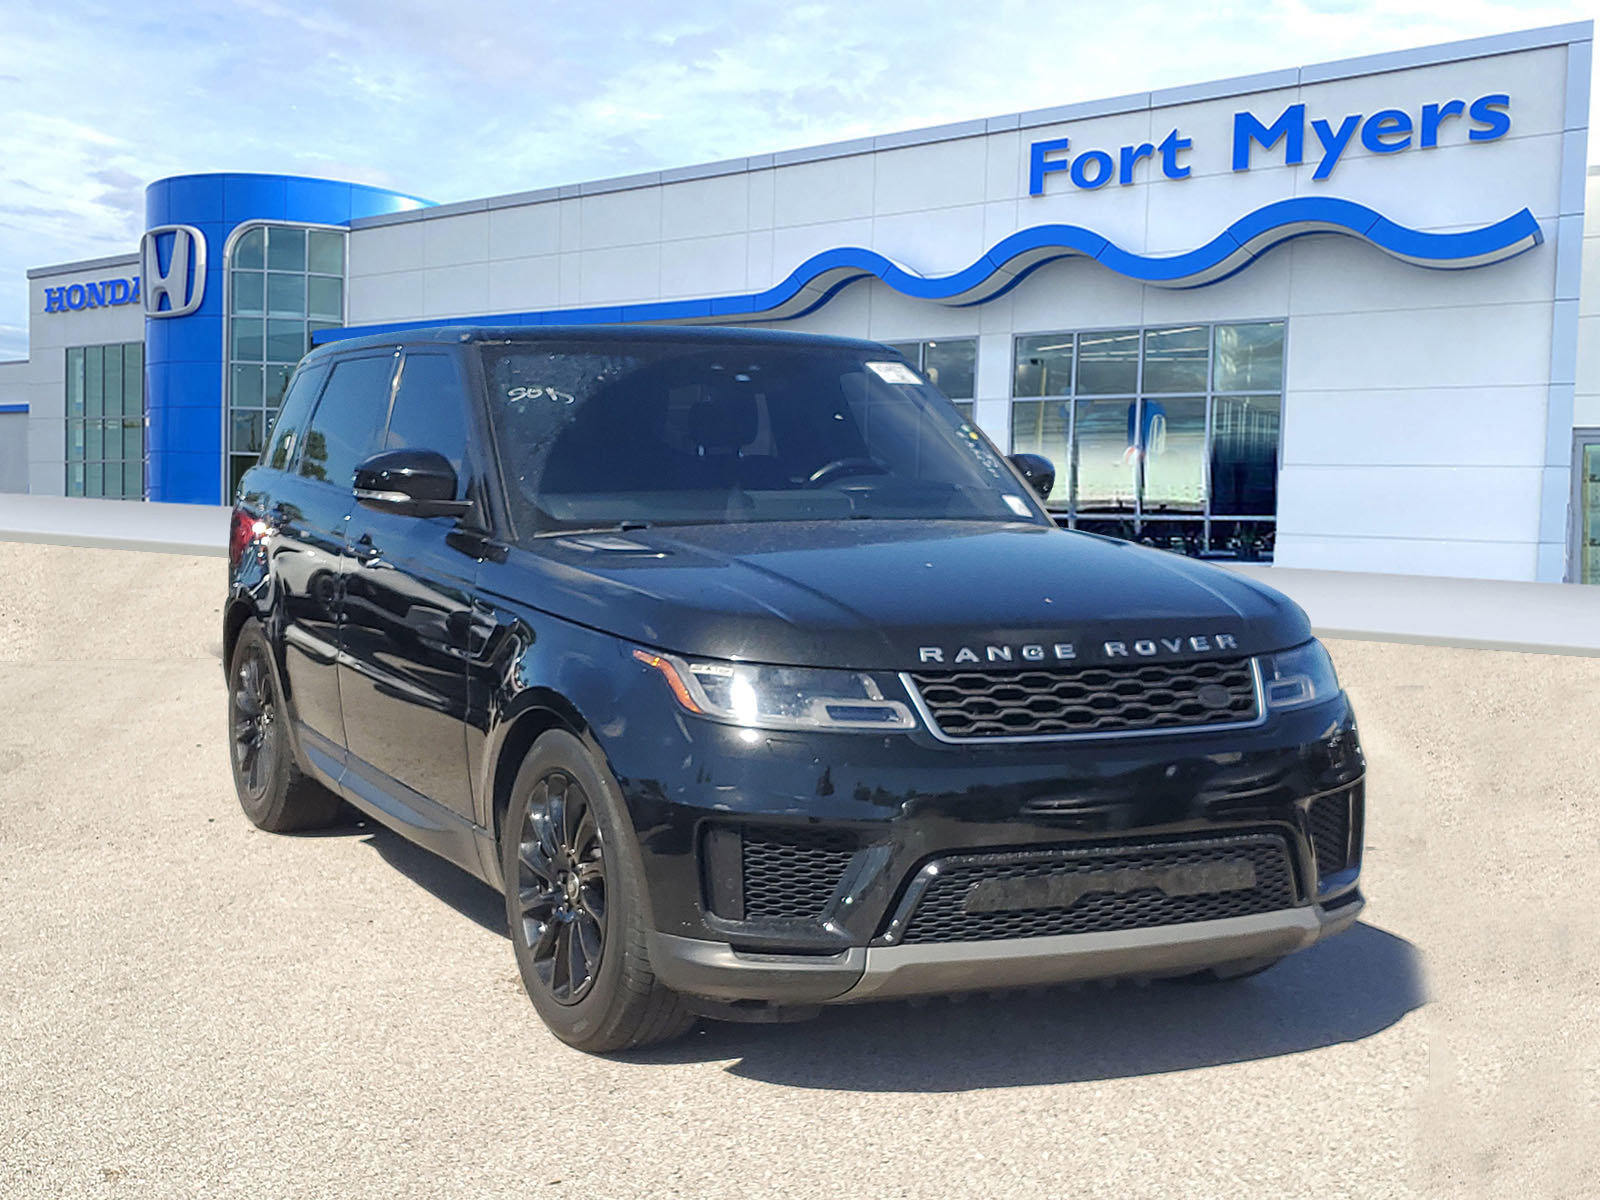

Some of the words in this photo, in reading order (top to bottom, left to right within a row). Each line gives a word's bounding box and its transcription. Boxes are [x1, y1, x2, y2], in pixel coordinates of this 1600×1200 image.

[1029, 128, 1193, 197] Fort
[1232, 92, 1512, 182] Myers
[919, 643, 1077, 663] RANGE
[1104, 633, 1238, 657] ROVER
